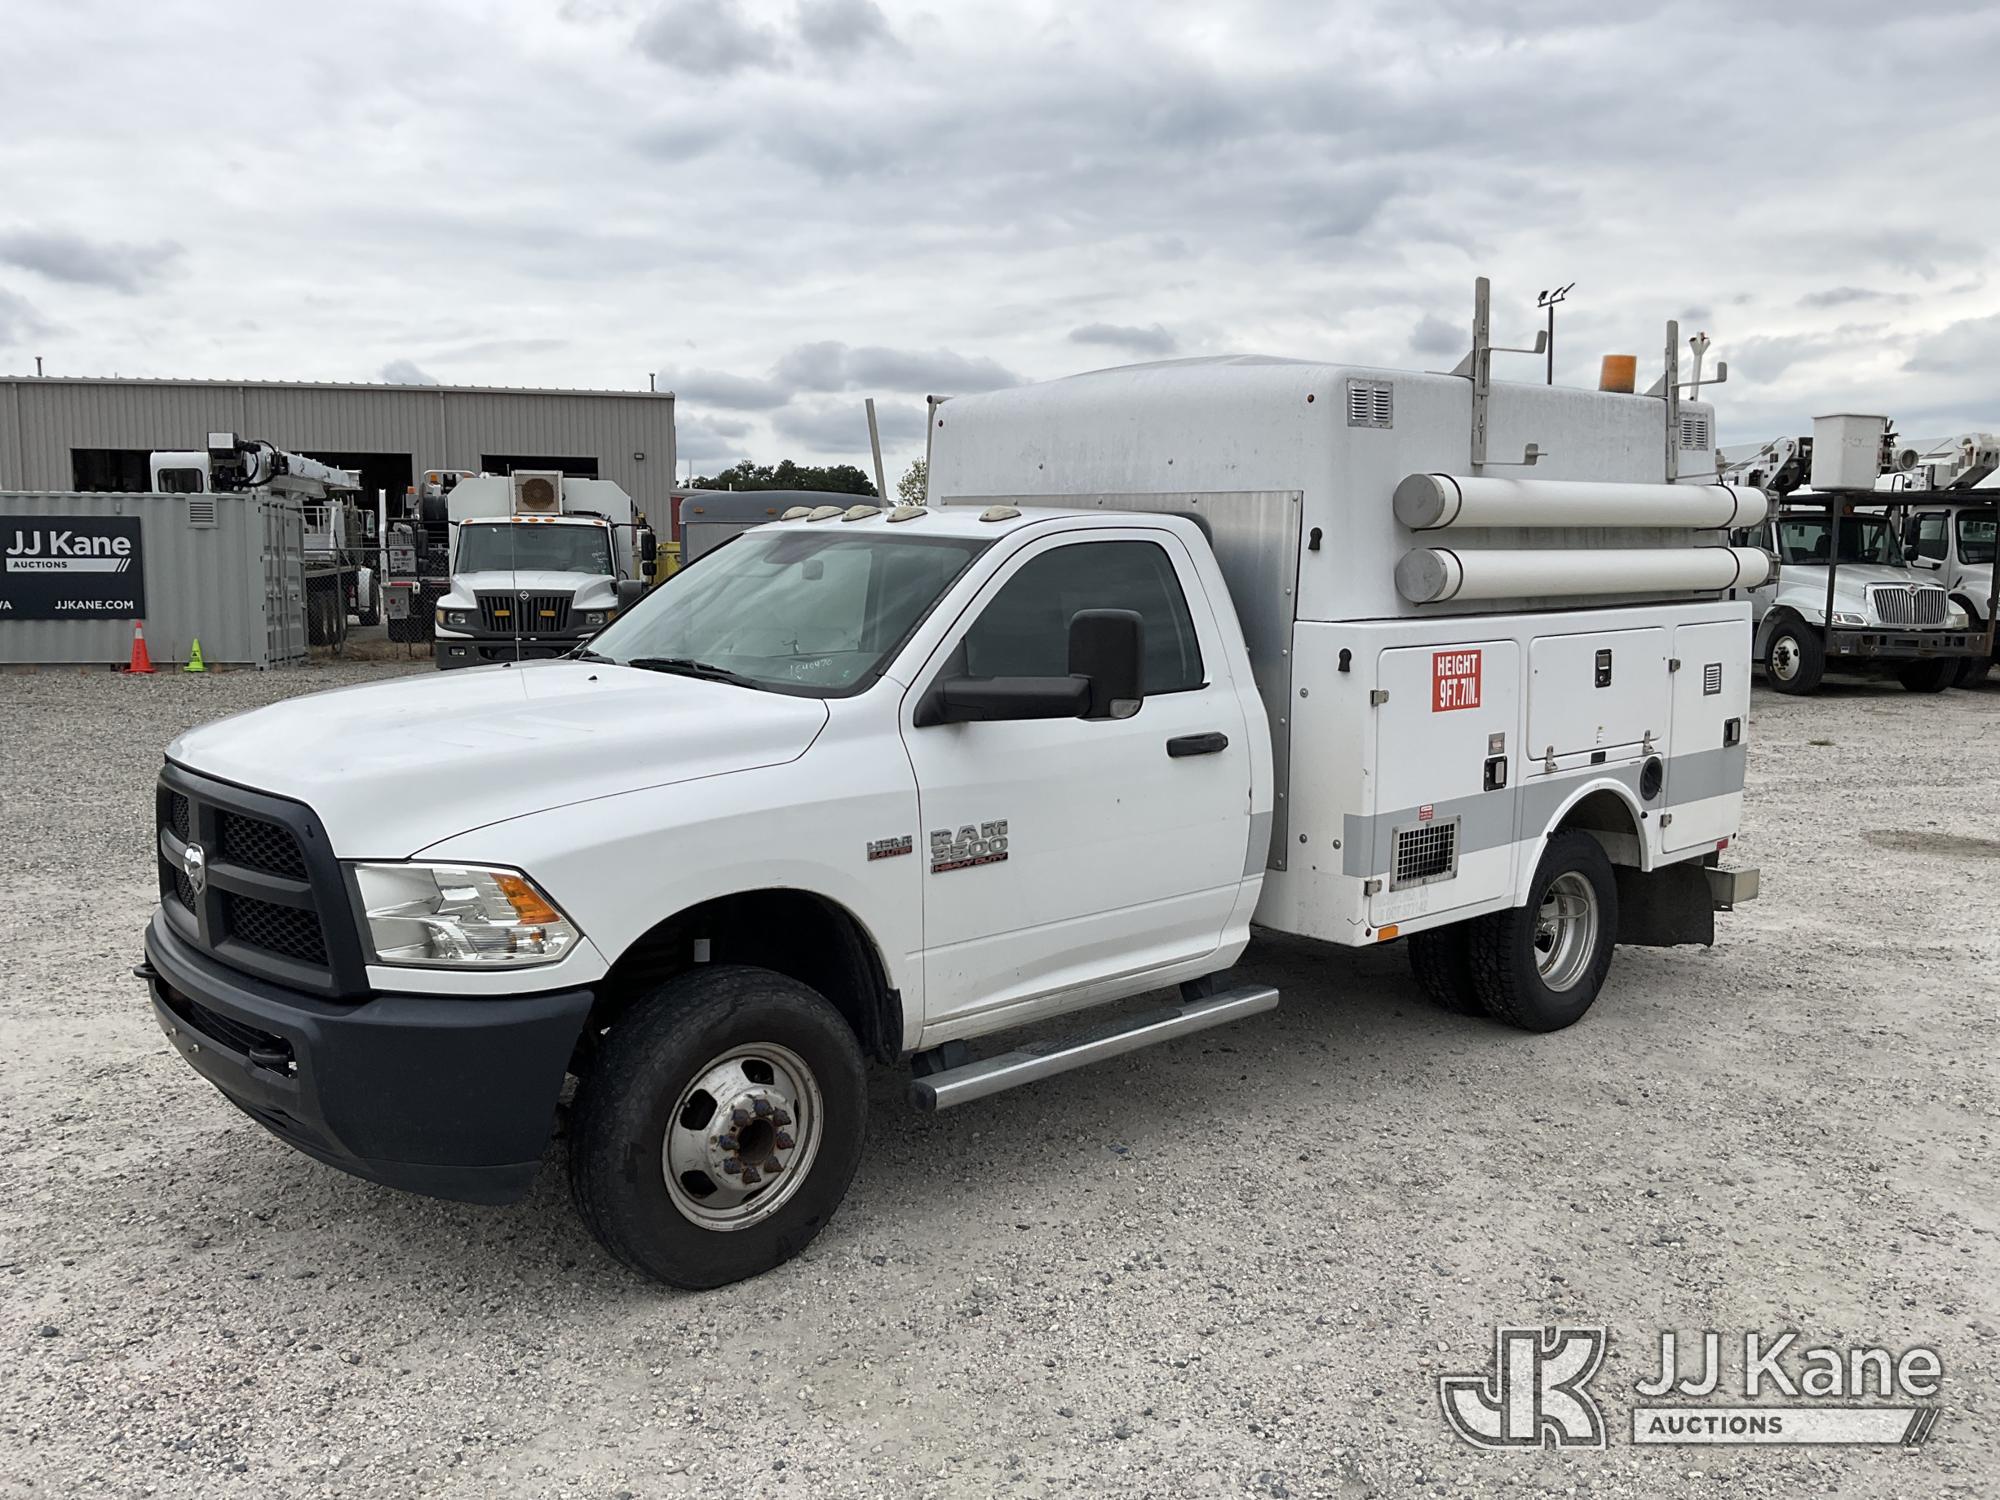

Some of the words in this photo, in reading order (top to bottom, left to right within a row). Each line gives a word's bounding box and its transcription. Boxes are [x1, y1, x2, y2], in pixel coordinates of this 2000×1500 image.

[6, 531, 41, 555] JJ
[50, 531, 131, 556] Kane
[13, 561, 68, 569] AUCTIONS
[55, 600, 134, 610] JJKANE.COM
[1437, 654, 1477, 677] HEIGHT
[931, 819, 1008, 847] RAM
[931, 835, 1008, 864] 3500
[933, 860, 973, 873] HEAVY
[974, 853, 1007, 866] DUTY
